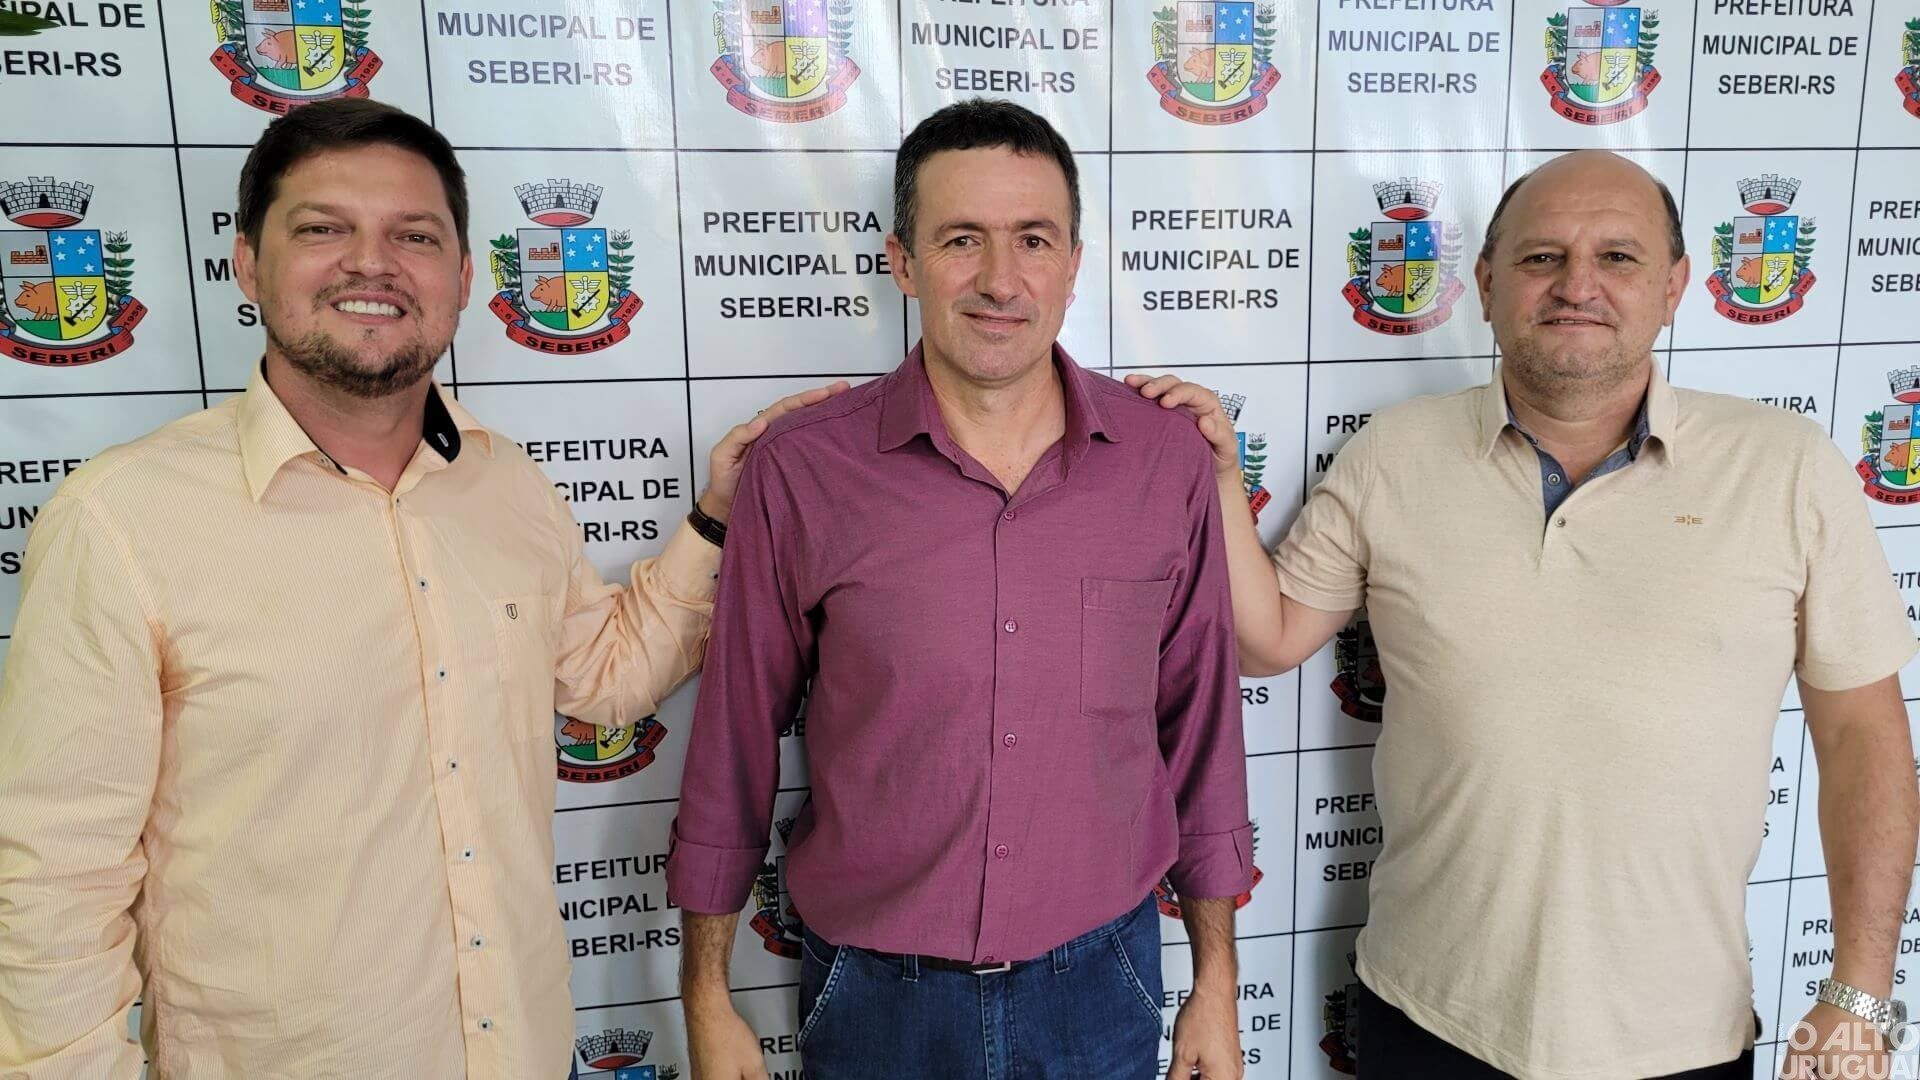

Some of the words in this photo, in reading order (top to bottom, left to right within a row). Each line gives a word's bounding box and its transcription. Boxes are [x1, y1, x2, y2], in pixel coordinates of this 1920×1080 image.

[0, 0, 89, 27] IPAL
[98, 2, 146, 28] DE
[1714, 0, 1854, 16] PREFEITURA
[438, 12, 606, 40] MUNICIPAL
[616, 17, 656, 41] DE
[911, 22, 1054, 50] MUNICIPAL
[1062, 28, 1099, 50] DE
[1328, 30, 1460, 53] MUNICIPAL
[1467, 31, 1500, 53] DE
[1702, 34, 1822, 56] MUNICIPAL
[1828, 36, 1859, 56] DE
[0, 50, 122, 77] ERI-RS
[468, 60, 633, 86] SEBERI-RS
[935, 68, 1075, 93] SEBERI-RS
[1347, 72, 1478, 94] SEBERI-RS
[1718, 74, 1836, 95] SEBERI-RS
[1175, 104, 1254, 123] SEBERI
[703, 211, 882, 233] PREFEITURA
[1131, 208, 1293, 231] PREFEITURA
[694, 254, 847, 276] MUNICIPAL
[855, 253, 891, 275] DE
[1121, 249, 1260, 271] MUNICIPAL
[1268, 248, 1300, 269] DE
[720, 296, 870, 319] SEBERI-RS
[1142, 289, 1278, 311] SEBERI-RS
[1726, 307, 1792, 323] SEBERI
[11, 342, 117, 364] SEBERI
[525, 333, 614, 353] SEBERI
[525, 437, 669, 462] EFEITURA
[642, 478, 680, 499] DE
[583, 519, 659, 542] RI-RS
[1315, 793, 1378, 815] PREF
[556, 853, 668, 884] EFEITUR
[571, 927, 680, 958] BERI-RS
[1251, 1013, 1282, 1032] DE
